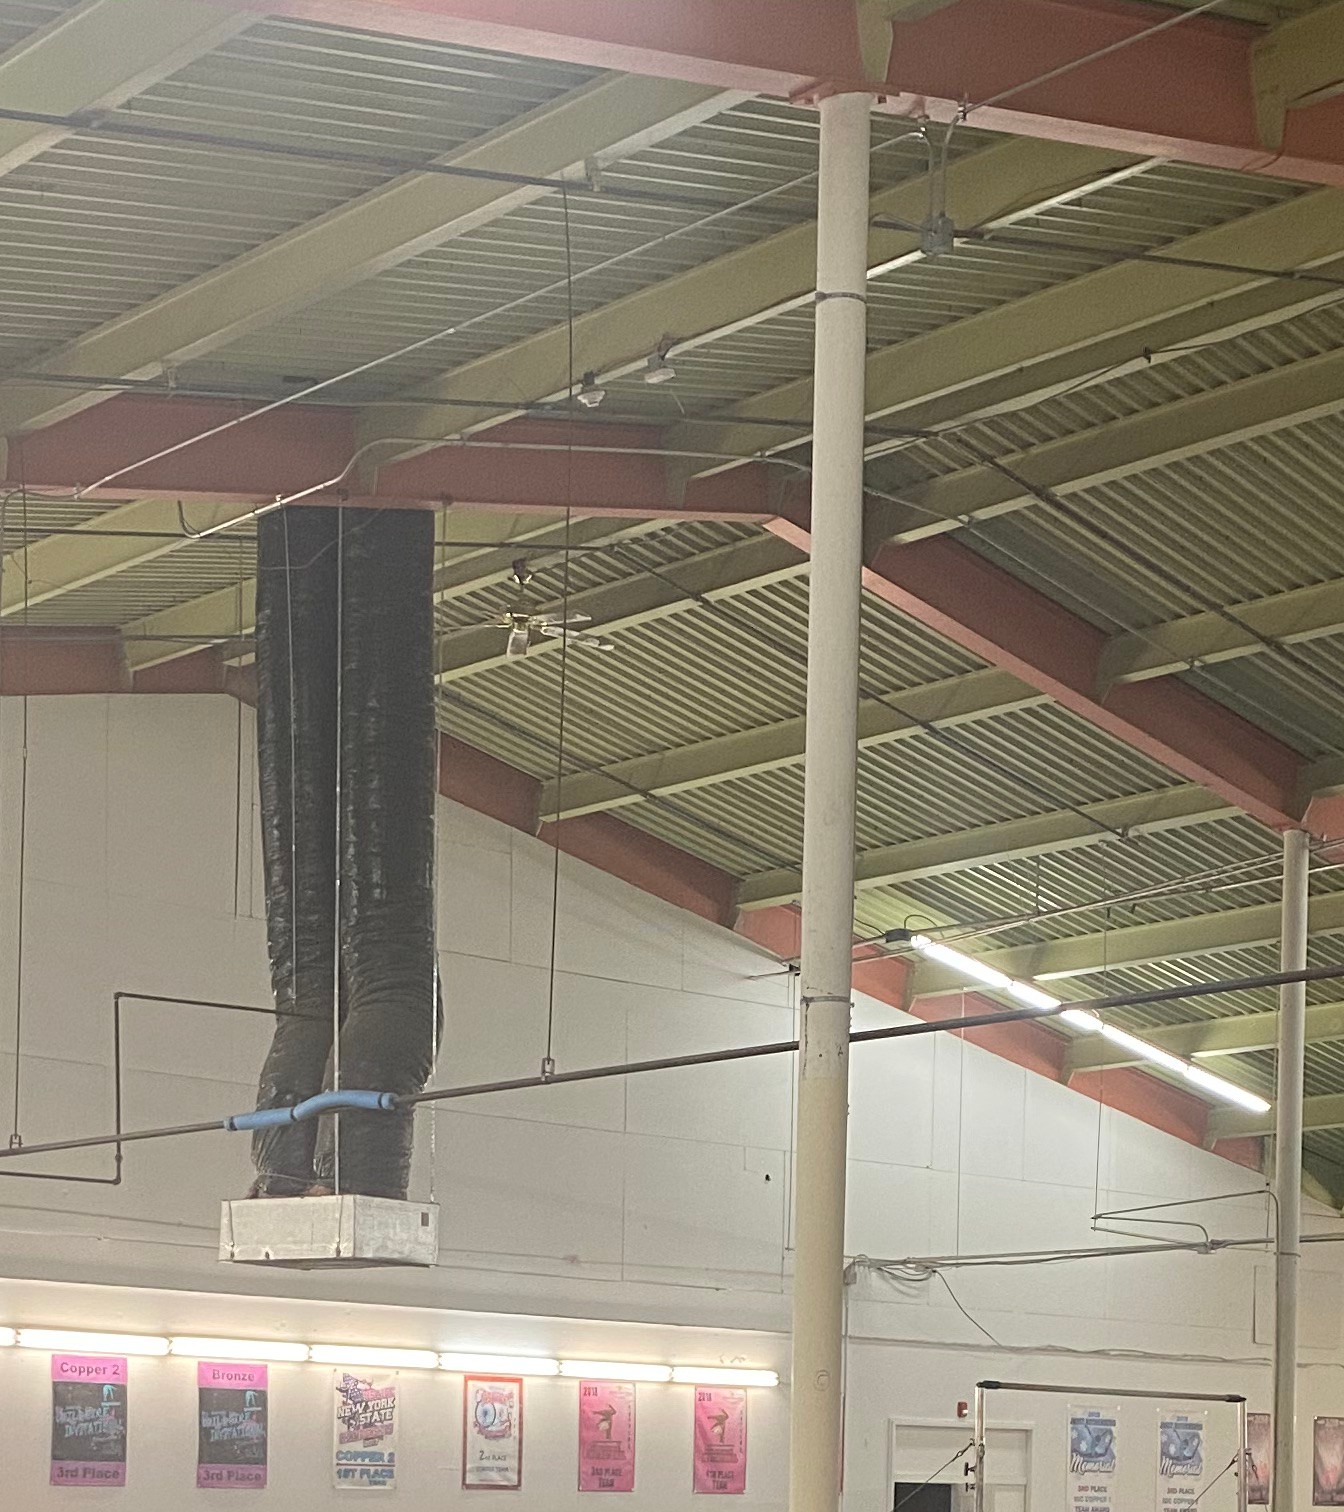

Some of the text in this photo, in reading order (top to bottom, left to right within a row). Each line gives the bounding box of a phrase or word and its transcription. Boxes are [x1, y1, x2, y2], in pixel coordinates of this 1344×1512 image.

[60, 1362, 120, 1376] Copper 2
[212, 1369, 254, 1381] Bronze
[337, 1397, 396, 1419] NEW YORK
[359, 1409, 393, 1425] STATE
[336, 1450, 385, 1462] COPPER
[57, 1467, 119, 1479] 3rd Place
[203, 1470, 261, 1481] 3rd Place
[360, 1468, 394, 1479] PLACE
